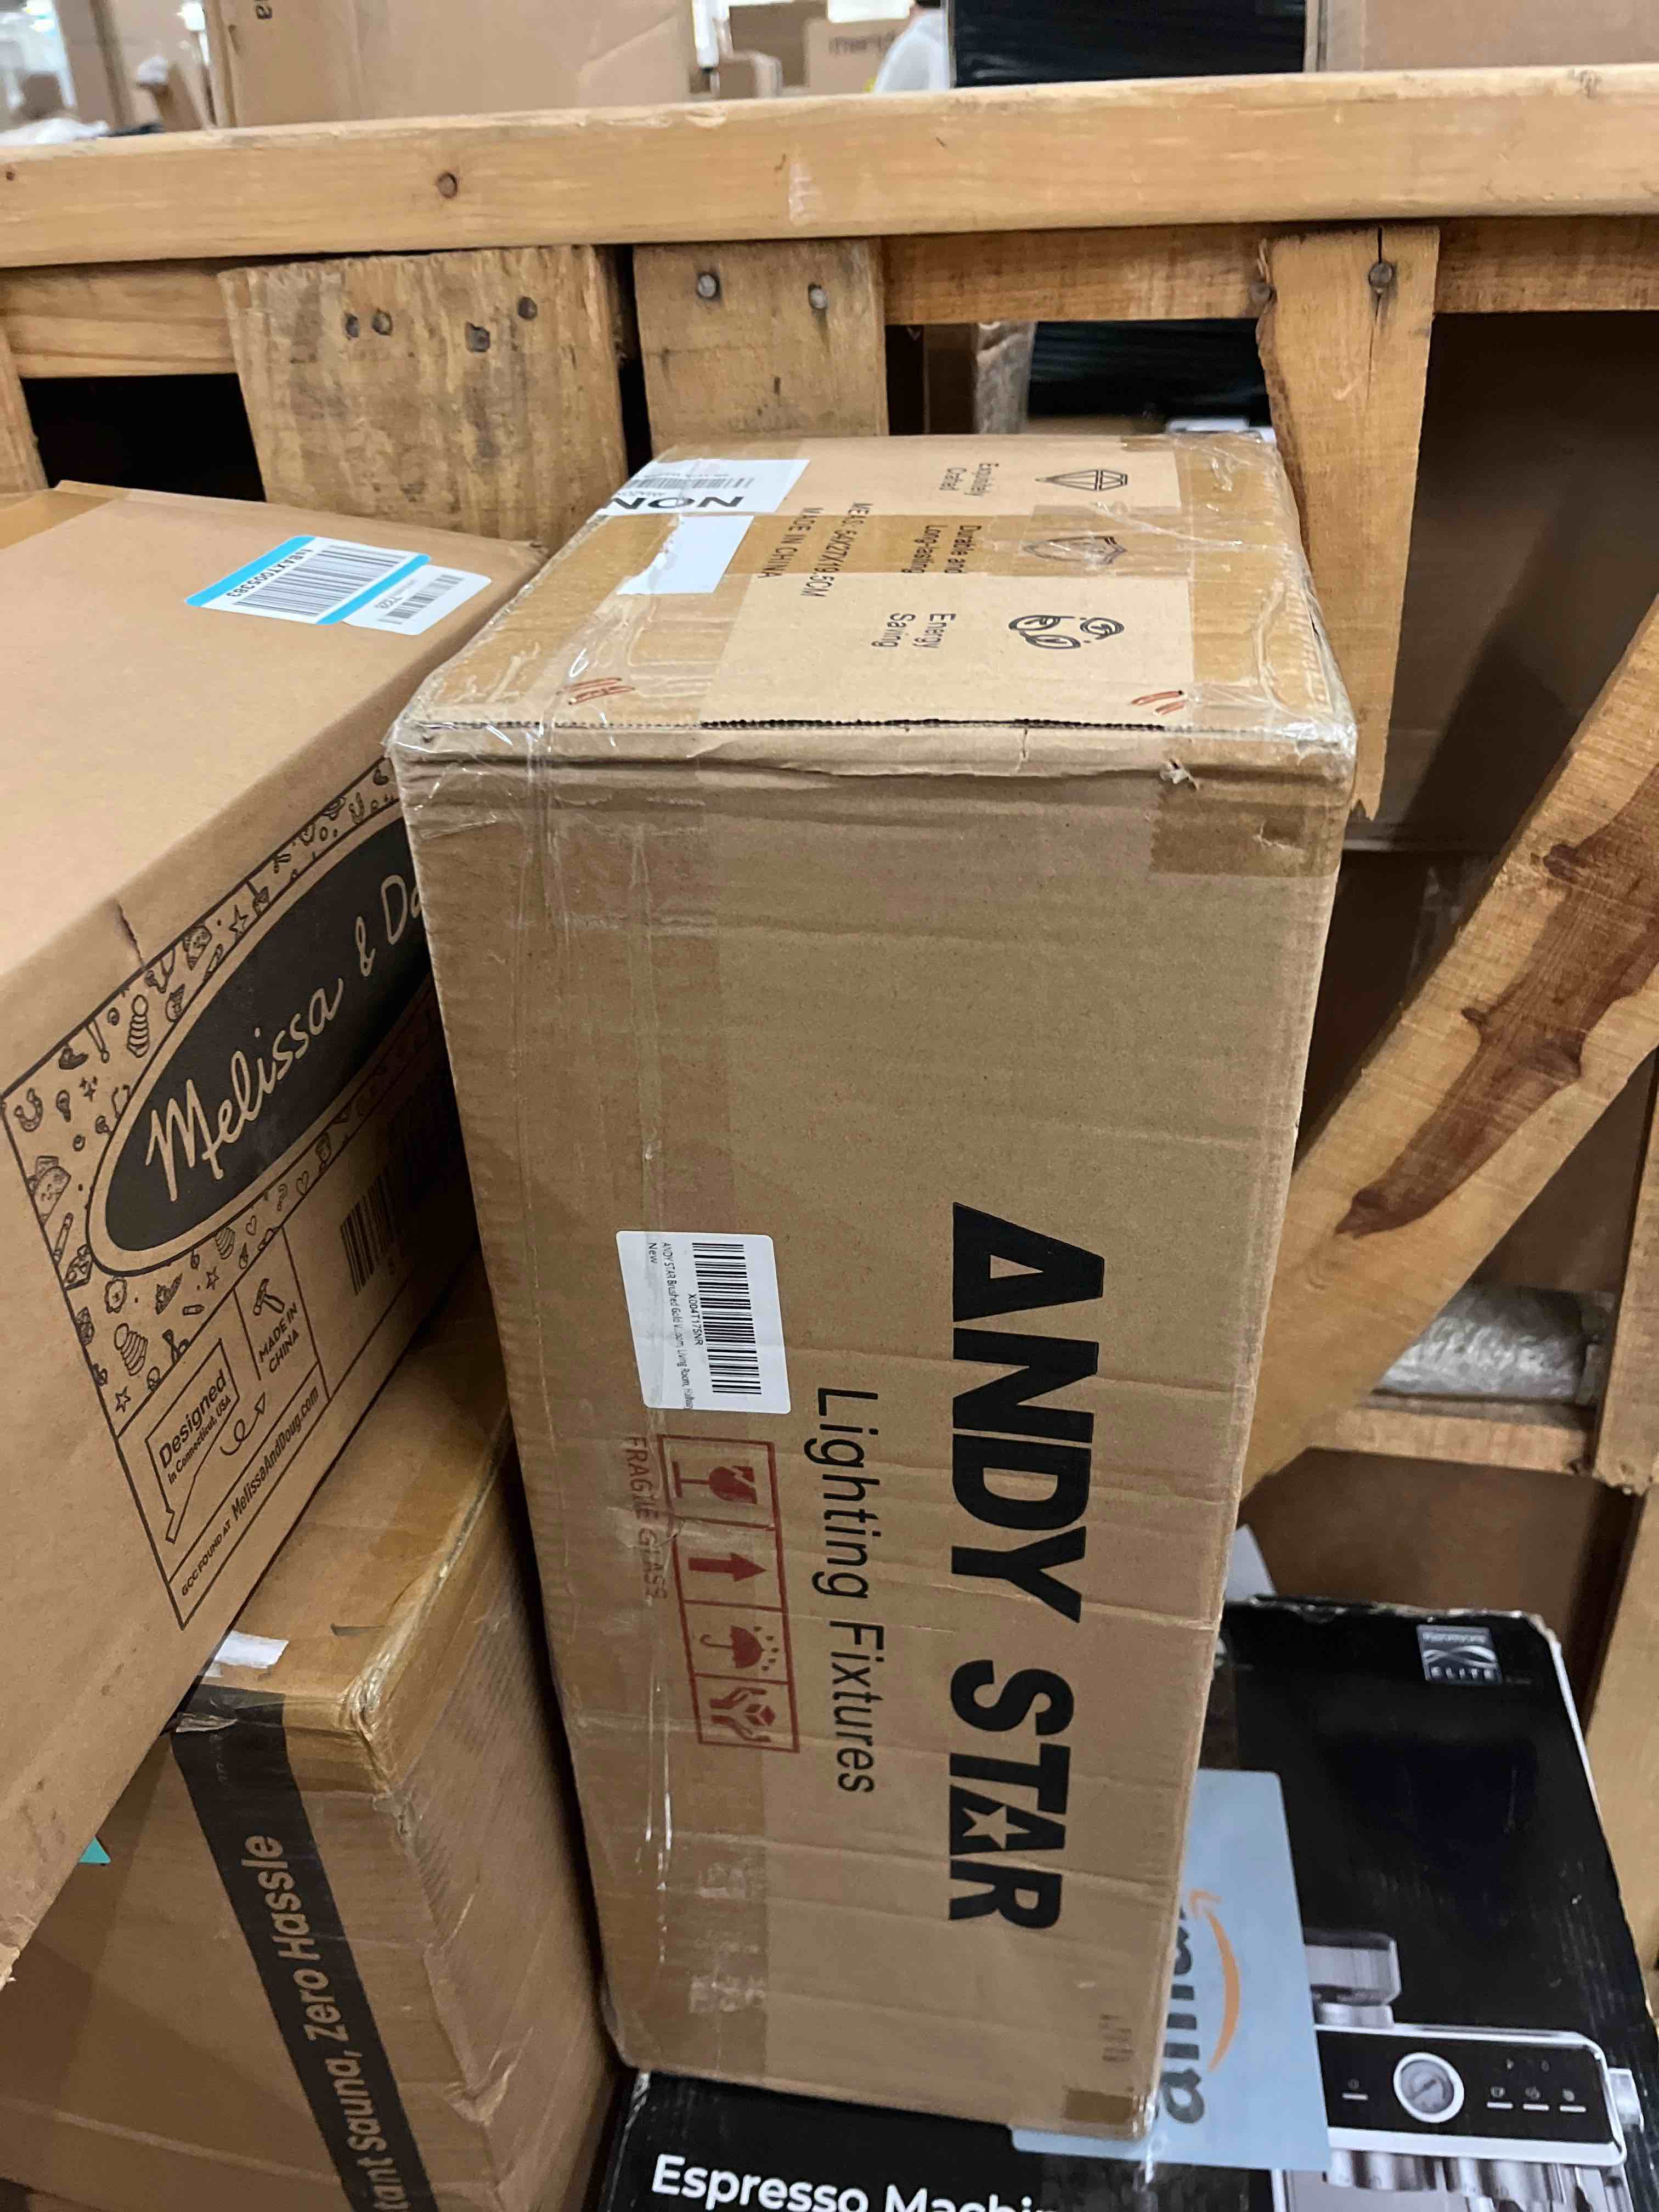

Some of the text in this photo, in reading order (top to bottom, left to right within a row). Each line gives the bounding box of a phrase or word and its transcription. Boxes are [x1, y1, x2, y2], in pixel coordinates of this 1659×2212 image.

[758, 507, 823, 578] MADE IN CHINA
[944, 525, 981, 573] Durable and
[871, 613, 916, 647] Saving
[913, 613, 956, 648] Energy
[145, 978, 343, 1202] Melissa
[356, 916, 376, 976] &
[648, 1242, 657, 1263] New
[663, 1242, 673, 1261] ANDY
[664, 1262, 676, 1278] STAR
[667, 1280, 680, 1306] Brushed
[672, 1308, 683, 1322] Gold
[259, 1302, 298, 1363] MADE IN
[269, 1329, 300, 1373] CHINA
[676, 1350, 687, 1367] Living
[159, 1369, 227, 1468] Designed
[167, 1395, 231, 1484] in Connecticut, USA
[182, 1387, 319, 1596] GCC FOUND AT MelissaAndDoug.com
[625, 1436, 658, 1519] FRAGILE
[804, 1387, 884, 1793] Lighting Fixtures
[949, 1201, 1104, 1929] ANDY STAR
[242, 1835, 320, 1961] Hassle
[293, 1968, 349, 2041] Zero
[652, 2154, 868, 2212] Espresso
